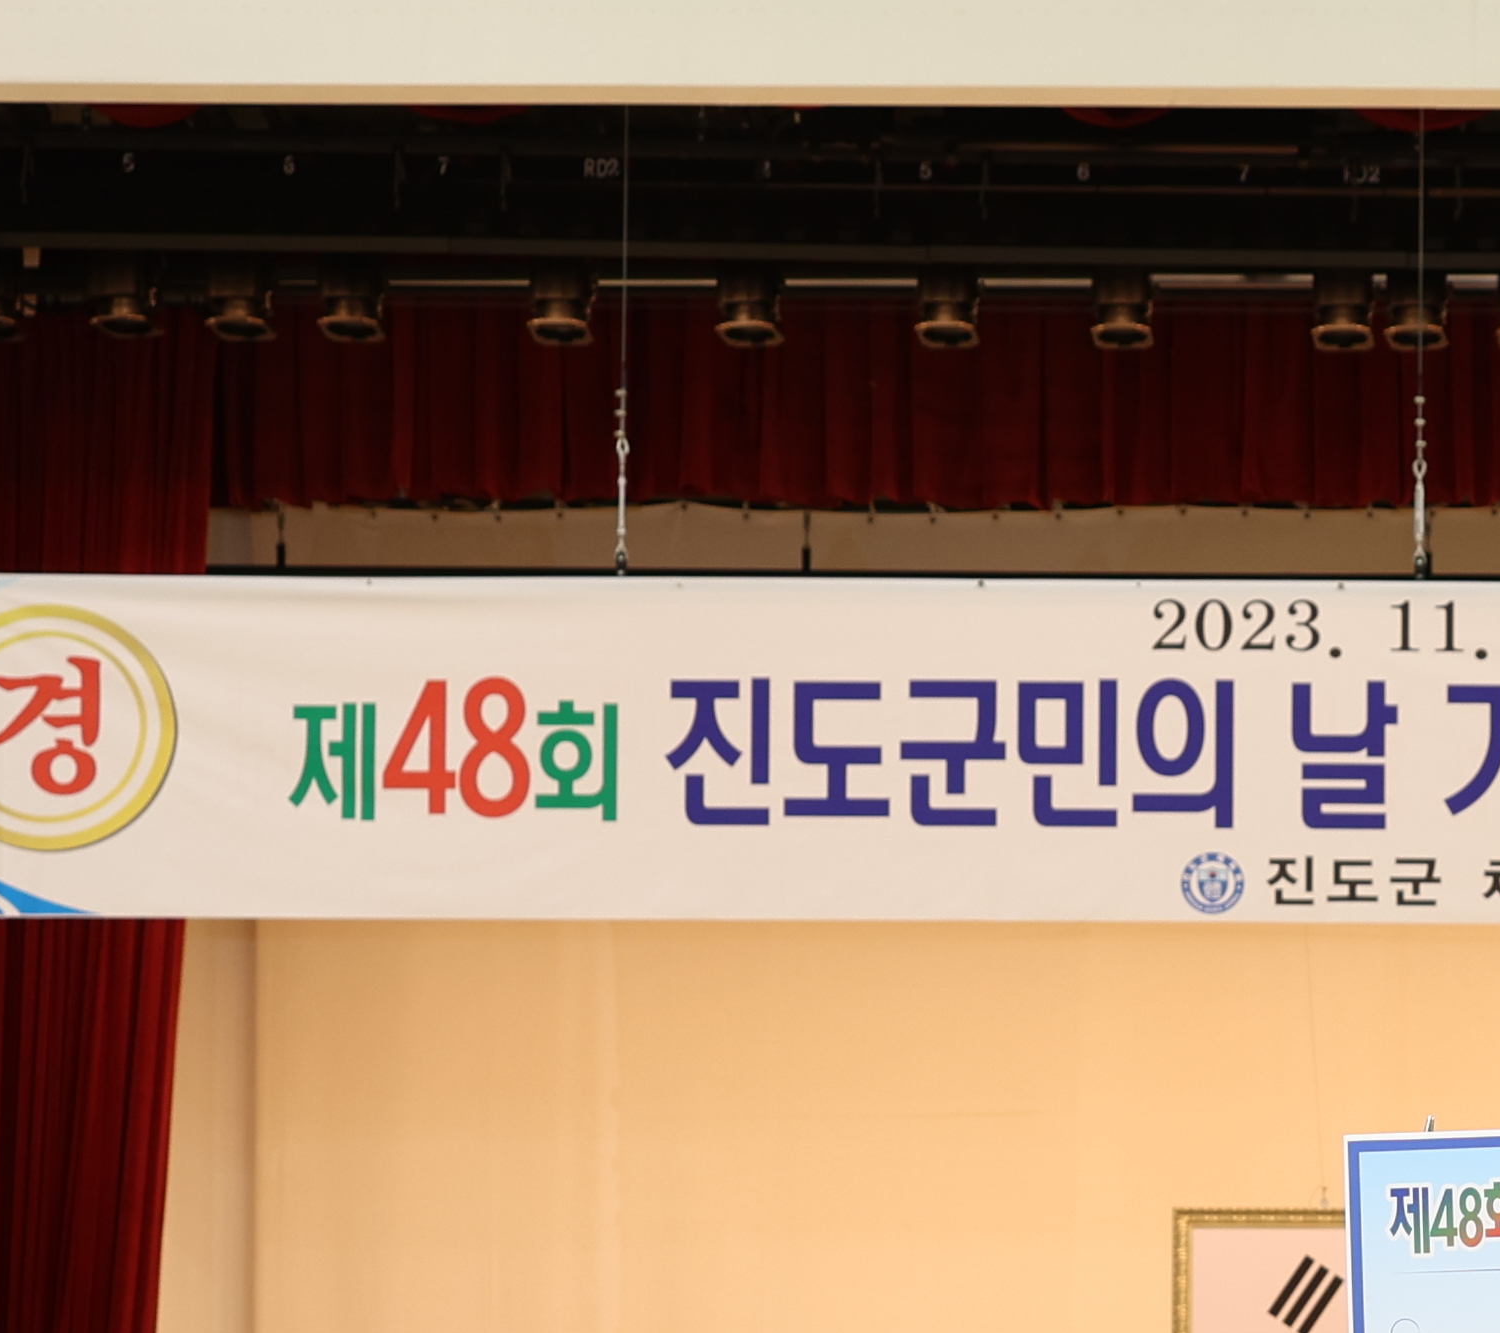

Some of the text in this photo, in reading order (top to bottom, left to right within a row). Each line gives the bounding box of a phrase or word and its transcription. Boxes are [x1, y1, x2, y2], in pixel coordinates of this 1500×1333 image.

[1150, 598, 1343, 659] 2023.
[1387, 598, 1490, 660] 11.
[288, 676, 620, 822] 제48회
[664, 677, 1236, 830] 진도군민의
[1290, 680, 1399, 831] 날
[1265, 855, 1443, 908] 진도군
